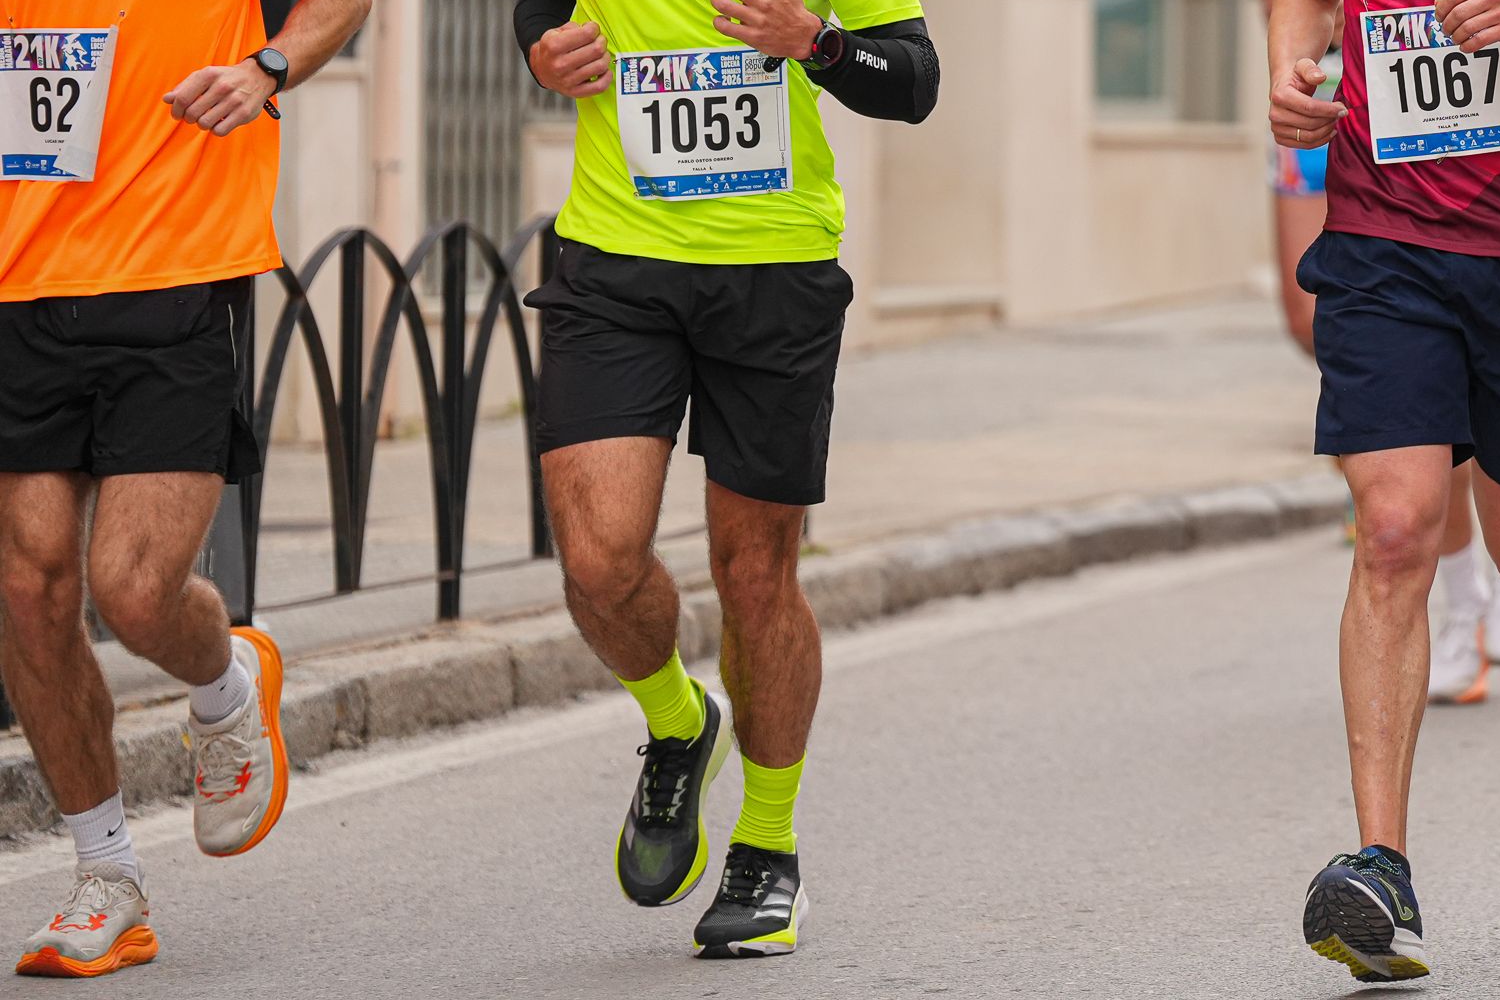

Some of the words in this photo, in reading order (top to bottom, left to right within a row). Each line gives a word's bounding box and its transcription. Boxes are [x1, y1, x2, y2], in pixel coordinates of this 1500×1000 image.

[1383, 13, 1430, 51] 21K
[14, 34, 61, 69] 21K
[856, 49, 888, 71] IPRUN
[639, 56, 691, 92] 21K
[721, 74, 741, 86] 2026
[1389, 48, 1500, 113] 1067
[29, 76, 81, 133] 62
[1436, 114, 1459, 122] PACHECO
[642, 93, 761, 154] 1053
